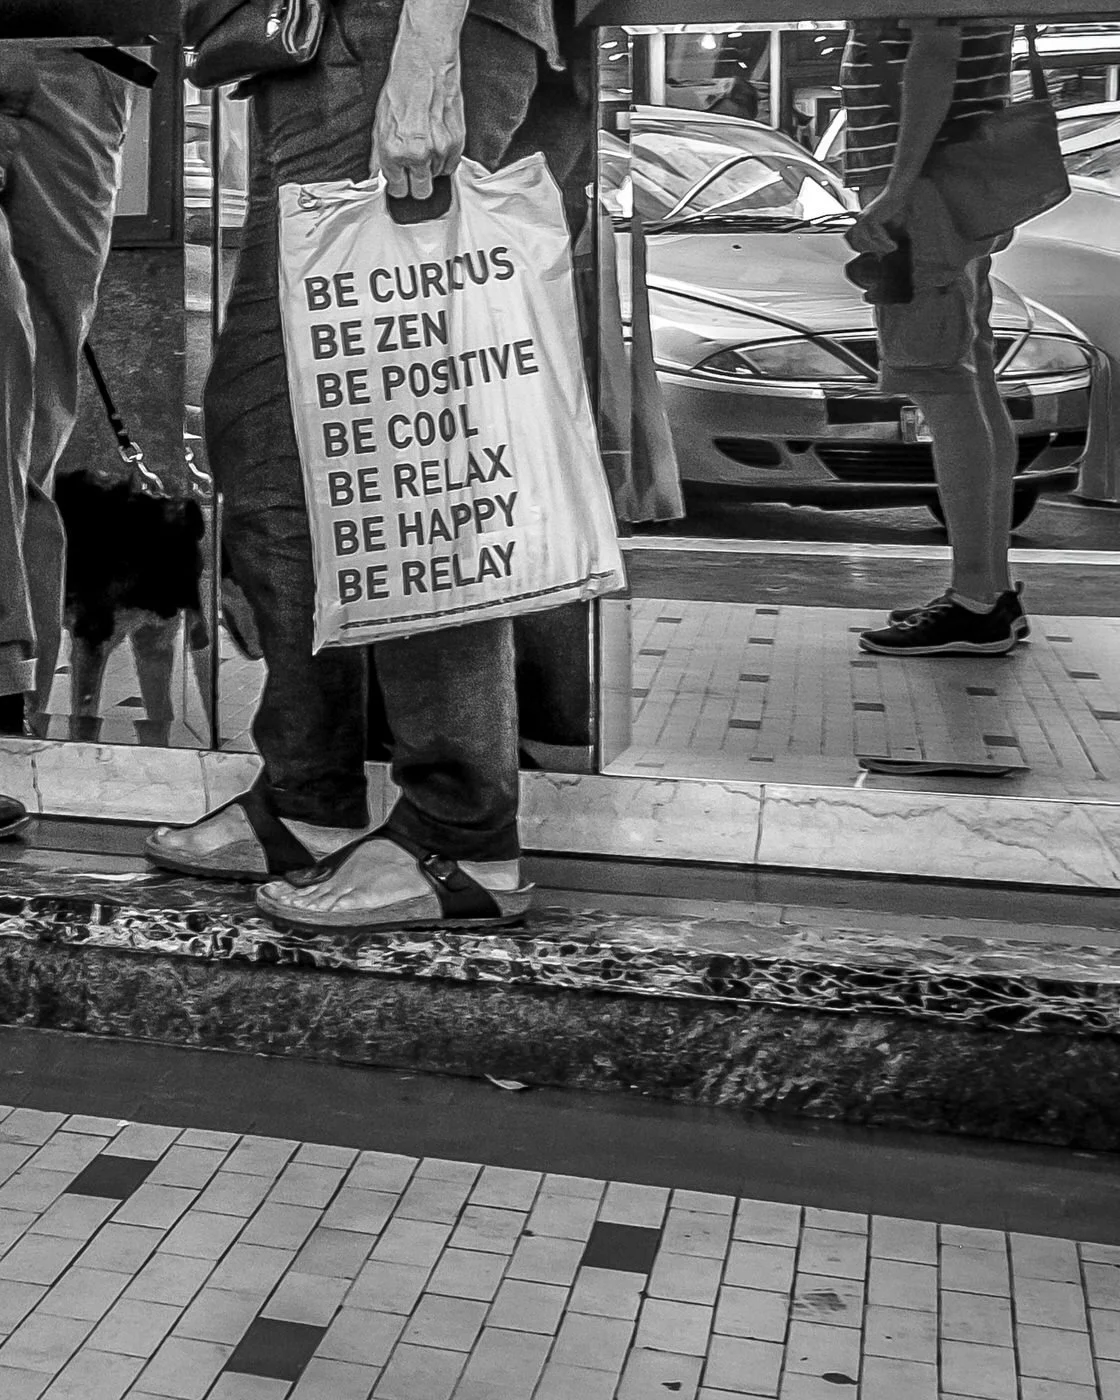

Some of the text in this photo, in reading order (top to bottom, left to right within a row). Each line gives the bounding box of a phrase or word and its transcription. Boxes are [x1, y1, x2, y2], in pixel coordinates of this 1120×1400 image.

[304, 272, 359, 311] BE
[310, 310, 448, 360] BE ZEN
[316, 338, 540, 409] BE POSITIVE
[322, 403, 479, 458] BE COOL
[328, 444, 513, 507] BE RELAX
[333, 492, 518, 556] BE HAPPY
[338, 541, 515, 605] BE RELAY
